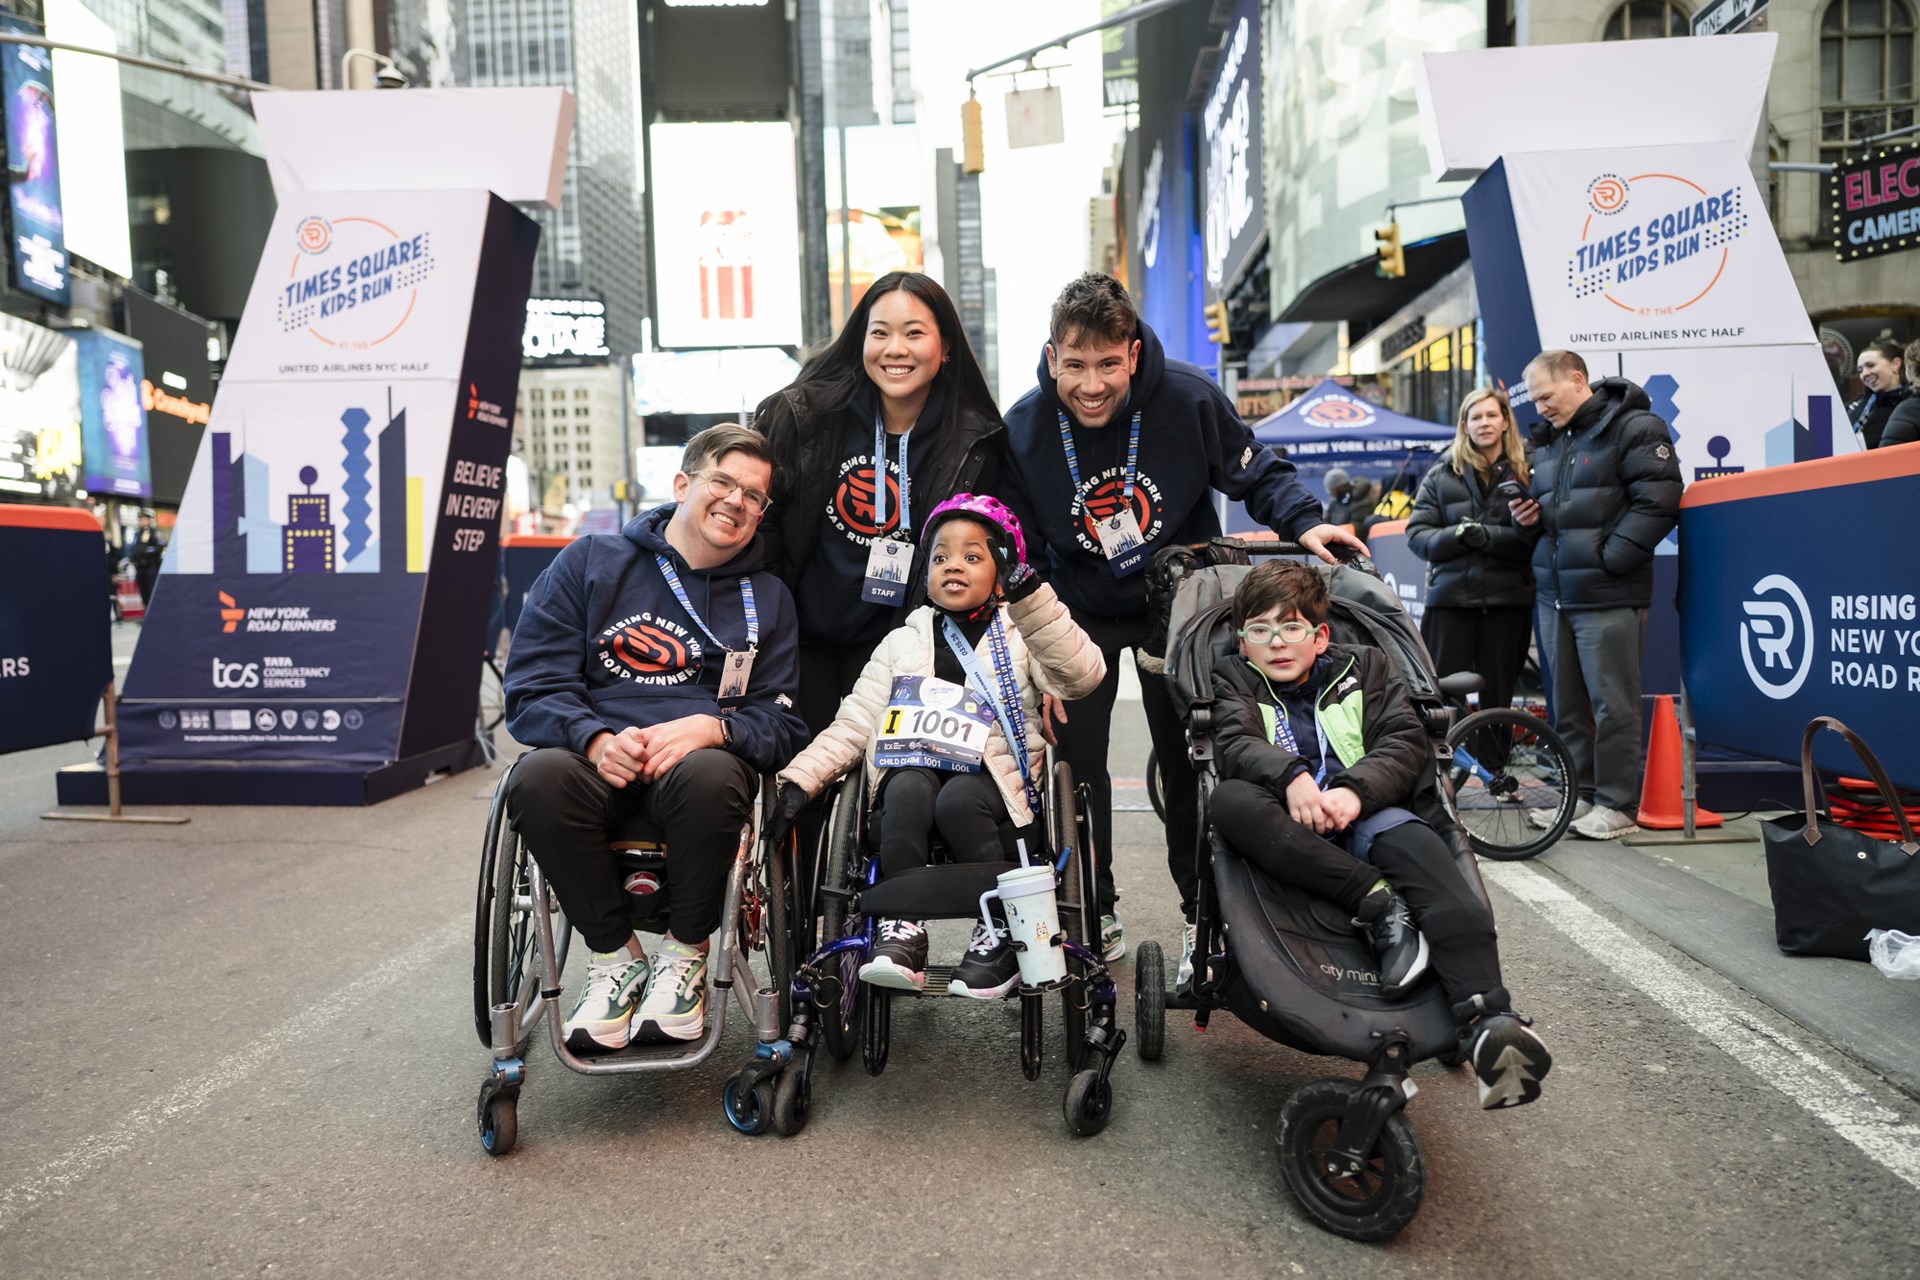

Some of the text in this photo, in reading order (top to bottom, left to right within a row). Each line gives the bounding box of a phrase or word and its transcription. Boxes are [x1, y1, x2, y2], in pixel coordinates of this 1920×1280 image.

[1701, 9, 1723, 36] ONE
[1845, 158, 1920, 211] ELEC
[1576, 188, 1734, 273] TIMES SQUARE
[286, 234, 423, 308] TIMES SQUARE
[1616, 232, 1700, 284] KIDS RUN
[320, 274, 393, 319] KIDS RUN
[1638, 306, 1673, 316] AT THE
[1570, 327, 1745, 343] UNITED AIRLINES NYC HALF
[278, 362, 430, 374] UNITED AIRLINES NYC HALF
[453, 459, 502, 489] BELIEVE
[1136, 471, 1163, 503] YORK
[445, 493, 500, 520] IN EVERY
[825, 497, 846, 532] OAD
[453, 528, 485, 551] STEP
[1119, 554, 1142, 570] STAFF
[871, 587, 897, 598] STAFF
[247, 607, 310, 619] NEW YORK
[1831, 594, 1917, 621] RISING
[247, 619, 338, 632] ROAD RUNNERS
[603, 612, 652, 637] RISING
[655, 616, 689, 638] NEW
[1831, 628, 1886, 655] NEW
[212, 657, 259, 689] tcs
[263, 657, 293, 667] TATA
[263, 667, 331, 678] CONSULTANCY
[598, 650, 698, 687] ROAD RUNNER
[1831, 661, 1898, 690] ROAD
[1005, 686, 1017, 708] UNITED
[912, 709, 973, 743] 1001
[879, 757, 900, 766] CHILD
[923, 756, 941, 768] 1001
[1320, 963, 1378, 982] city mini
